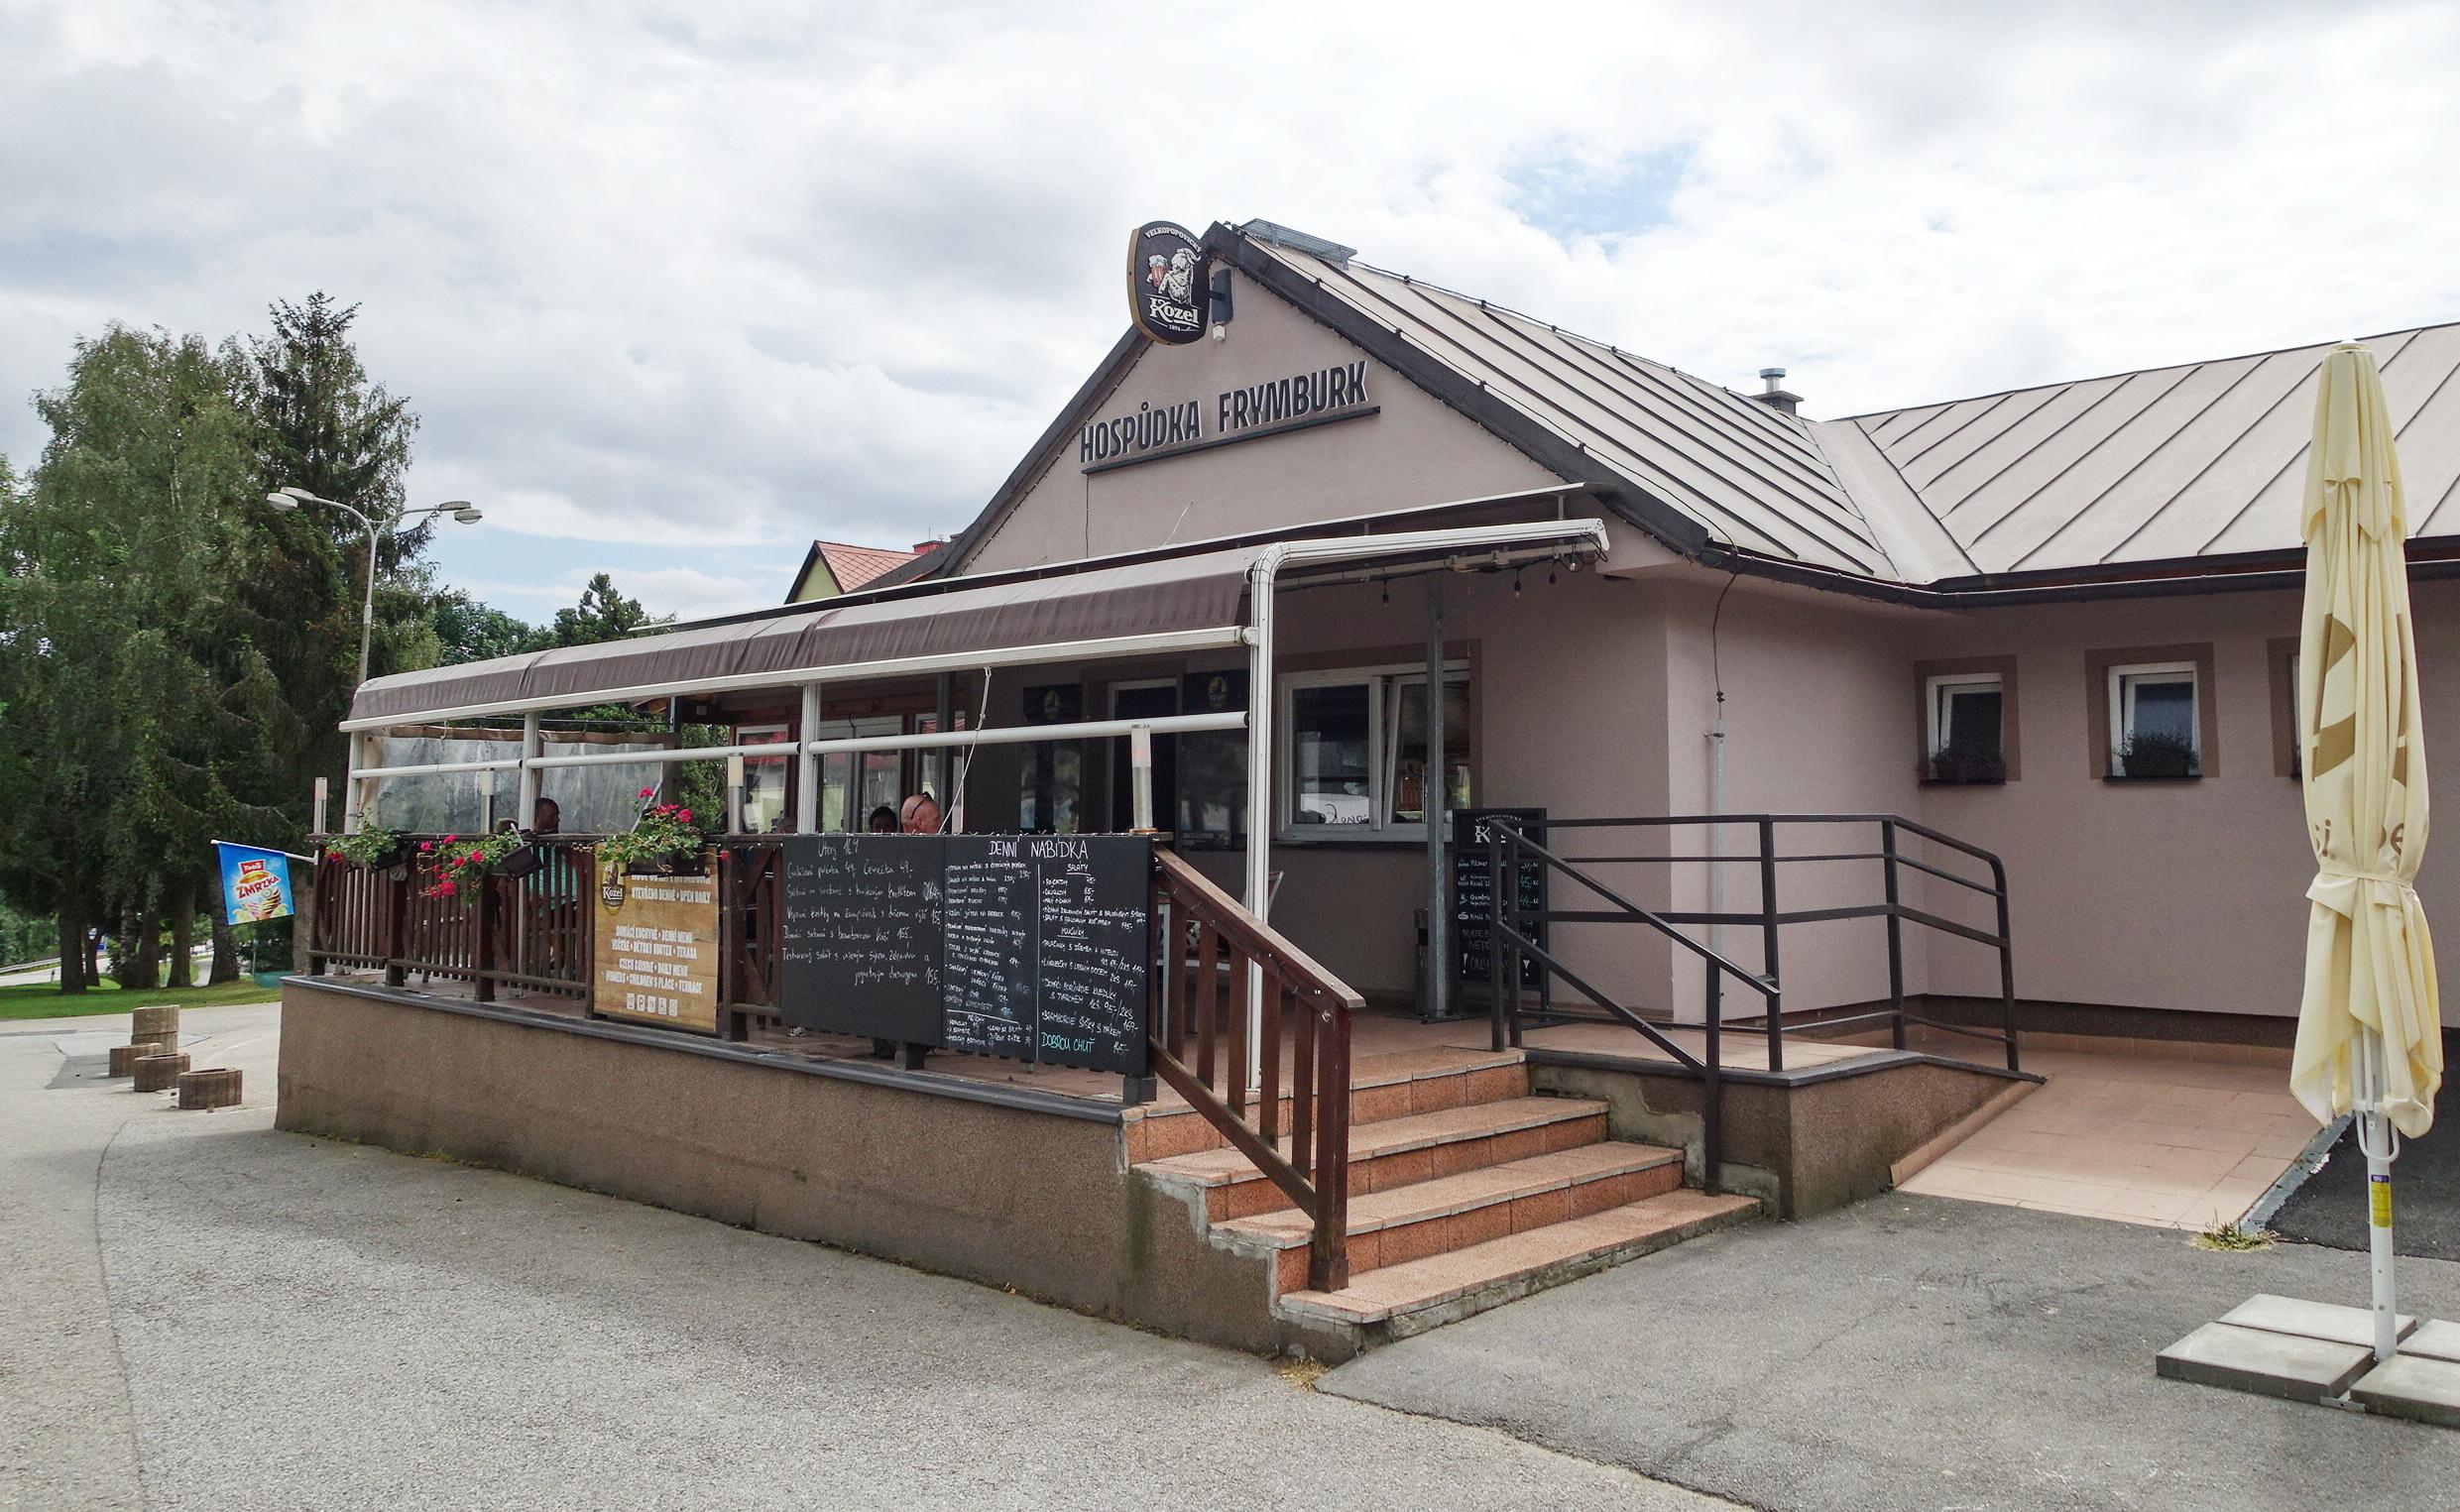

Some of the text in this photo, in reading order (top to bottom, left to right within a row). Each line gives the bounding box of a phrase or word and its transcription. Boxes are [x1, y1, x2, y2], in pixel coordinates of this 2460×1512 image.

[1149, 297, 1200, 326] Kozel
[1080, 360, 1369, 463] HOSPŮDKA FRYMBURK
[989, 837, 1089, 860] DENNÍ NABÍDKA
[1067, 861, 1088, 872] SALÁTY
[236, 875, 280, 899] ZMRZKA
[602, 886, 624, 900] Kozel
[680, 890, 694, 902] OPEN
[695, 891, 710, 904] DAILY
[1041, 1031, 1072, 1051] DOBROU
